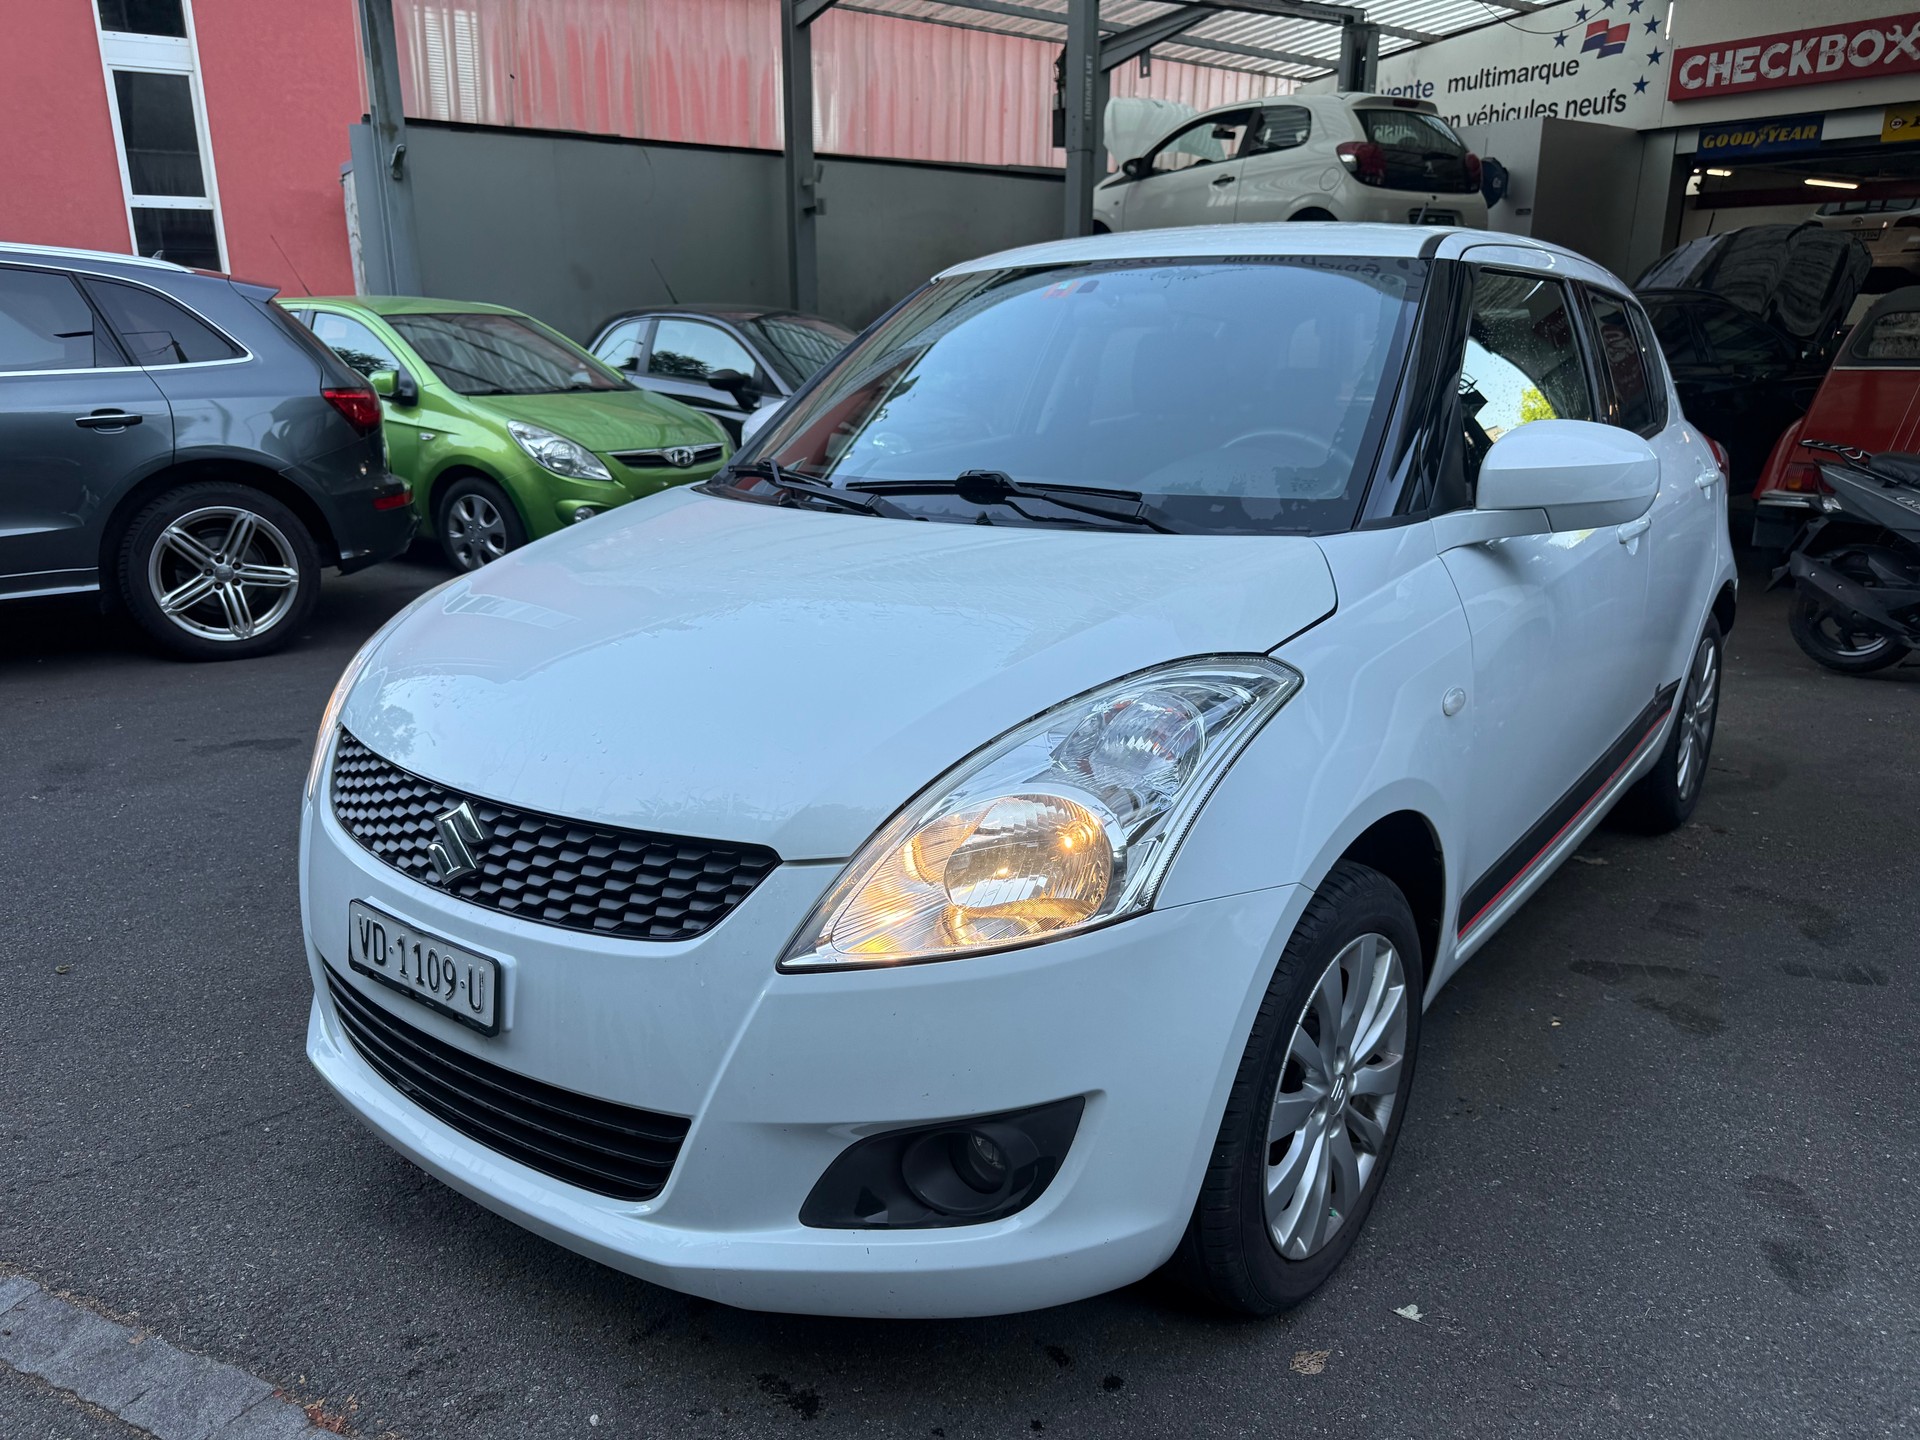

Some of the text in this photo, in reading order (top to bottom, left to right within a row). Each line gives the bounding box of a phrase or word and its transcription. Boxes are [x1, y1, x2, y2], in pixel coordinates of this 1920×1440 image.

[1447, 59, 1579, 93] multimarque
[1467, 99, 1558, 127] véhicules
[1565, 88, 1627, 118] neufs
[1703, 124, 1818, 149] GOODYEAR
